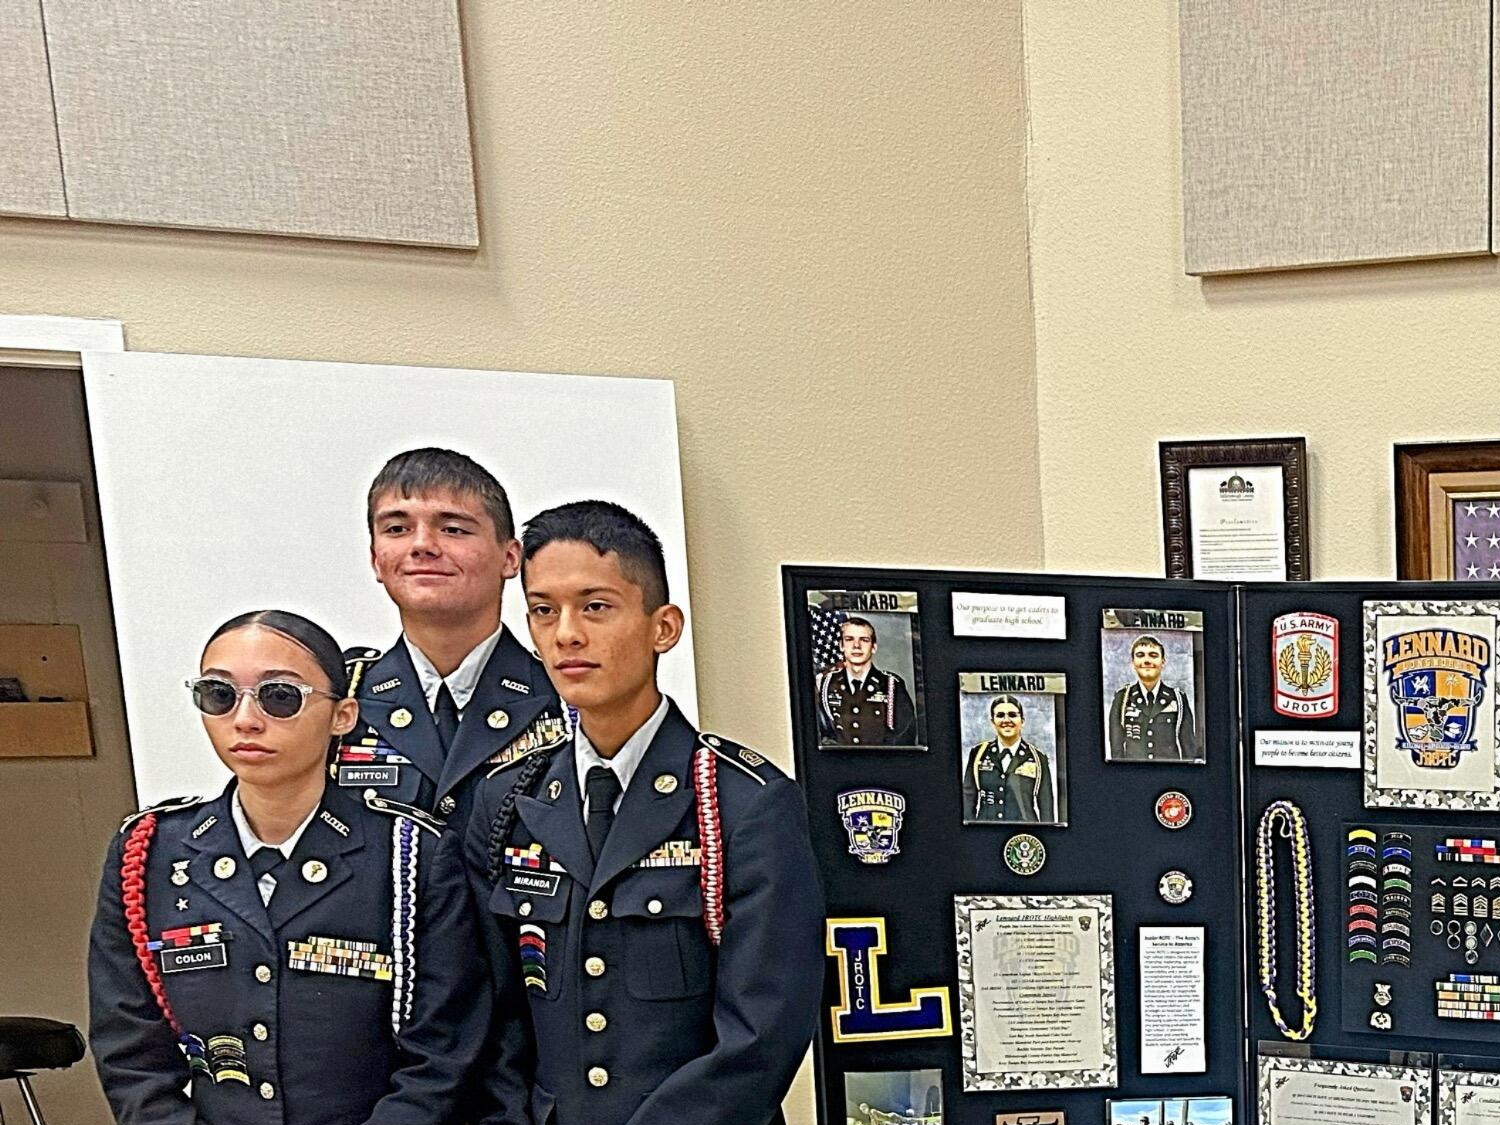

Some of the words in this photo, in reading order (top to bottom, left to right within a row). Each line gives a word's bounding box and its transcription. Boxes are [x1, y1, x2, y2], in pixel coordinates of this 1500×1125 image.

[831, 594, 898, 610] LENNARD
[1123, 612, 1185, 628] LENNARD
[1300, 619, 1332, 631] ARMY
[1385, 631, 1489, 667] LENNARD
[981, 675, 1045, 691] LENNARD
[1283, 700, 1328, 712] JROTC
[347, 772, 389, 780] BRITTON
[841, 791, 902, 811] LENNARD
[319, 810, 350, 837] ROTC
[513, 876, 550, 888] MIRANDA
[175, 952, 211, 964] COLON
[826, 917, 953, 1043] L
[854, 949, 864, 1010] JROTC
